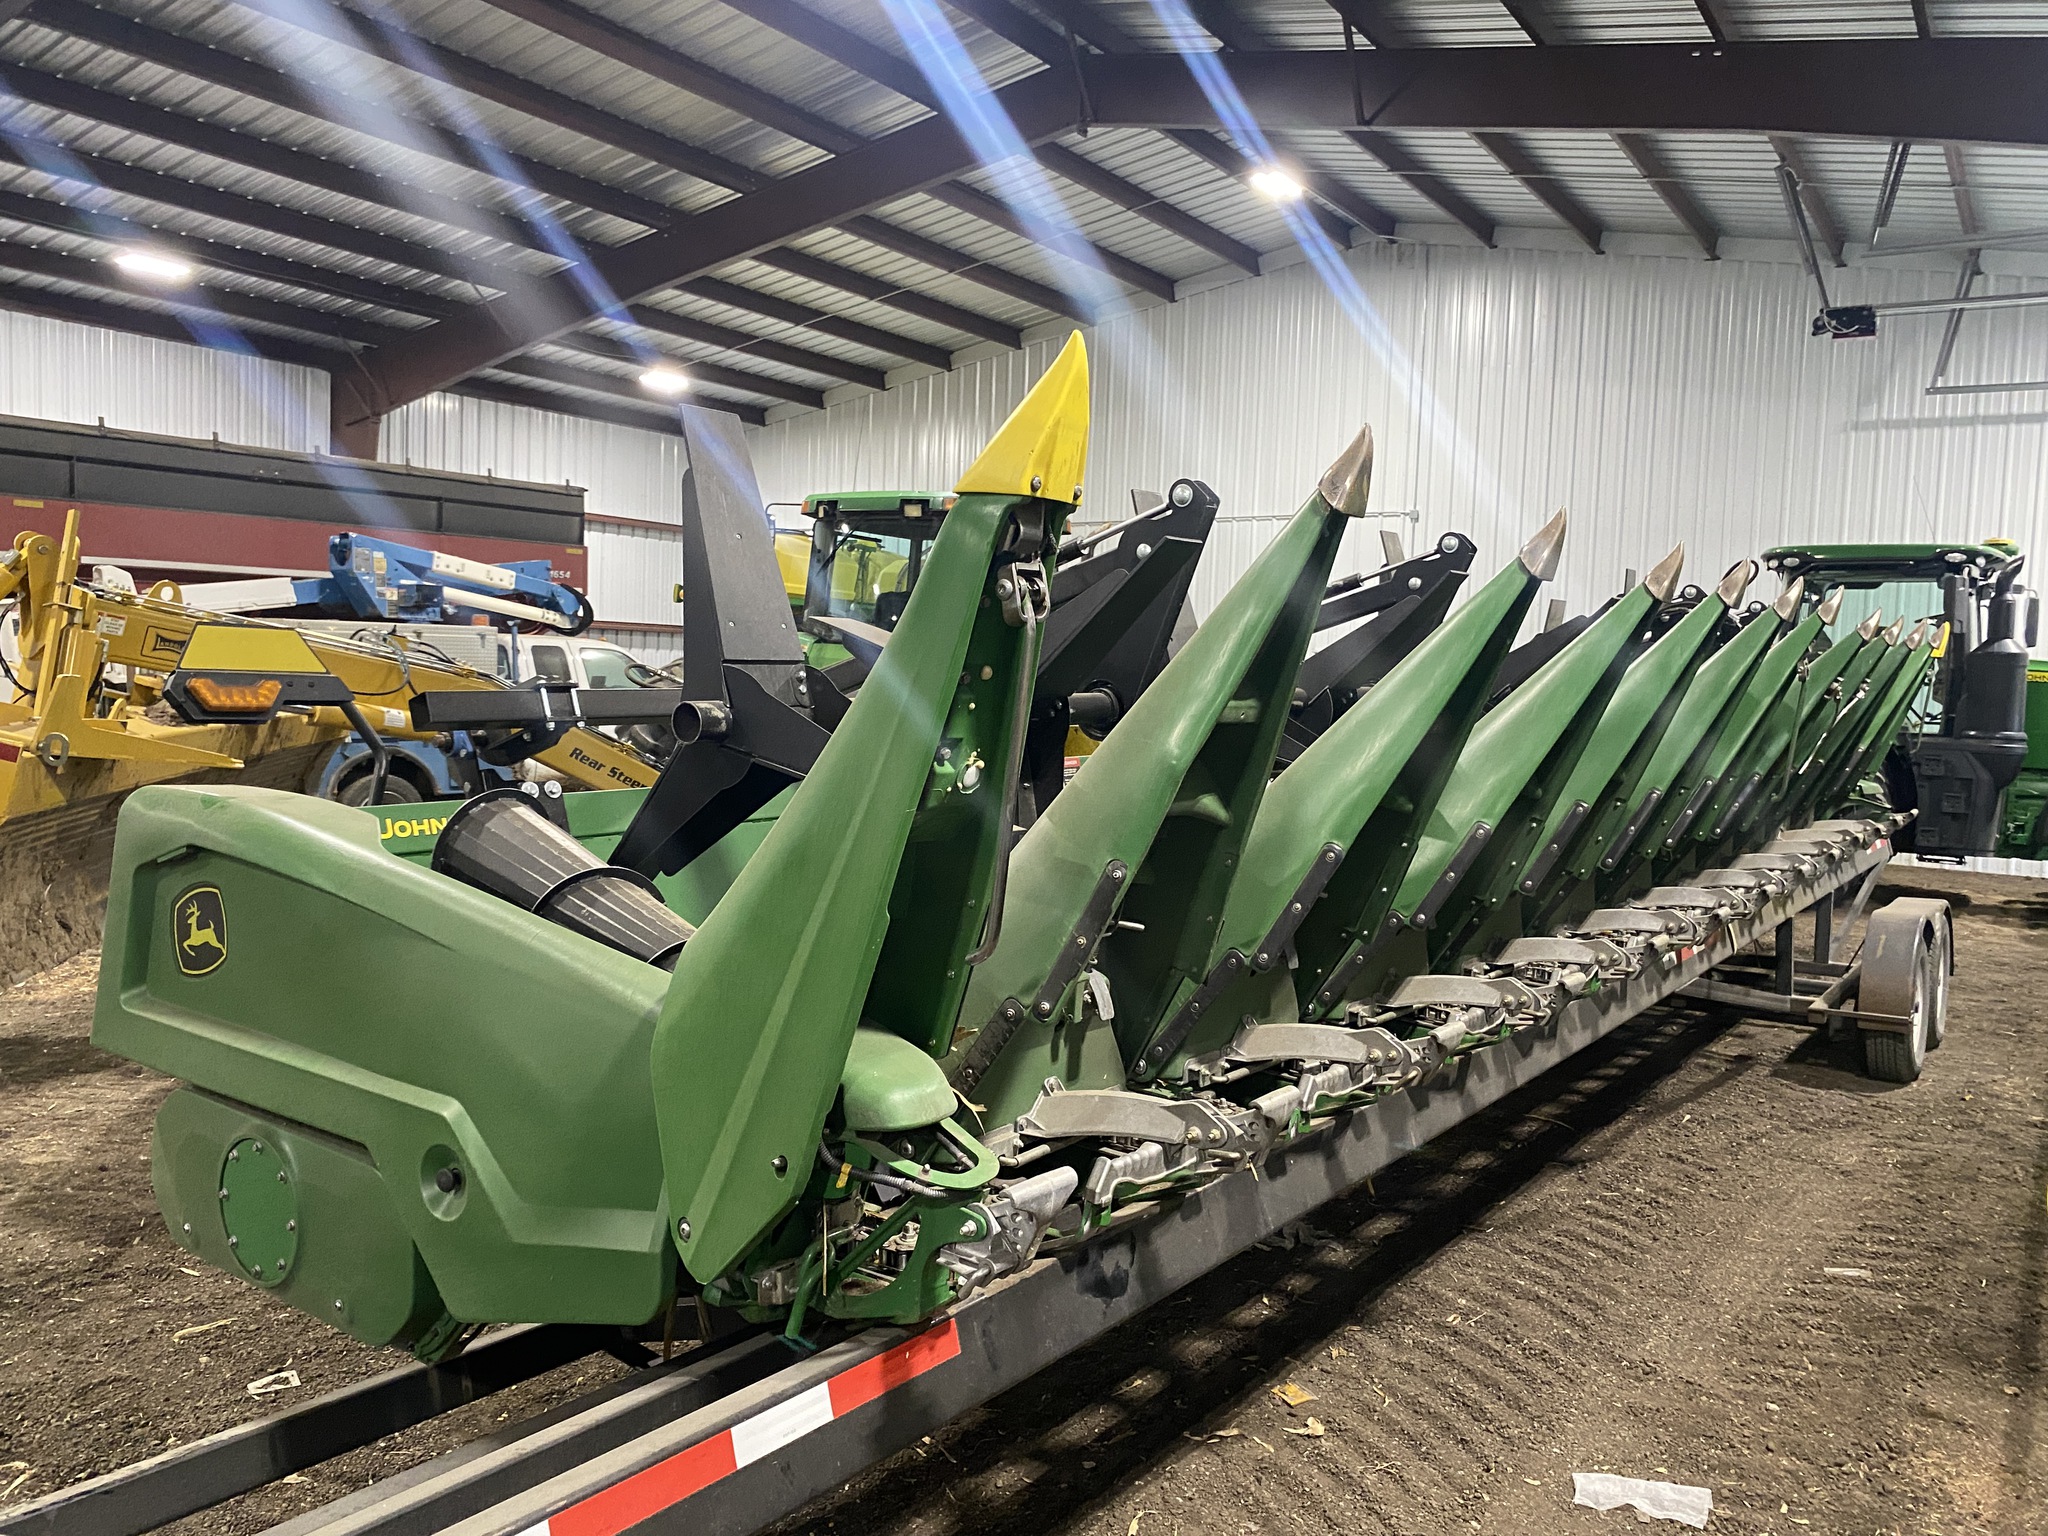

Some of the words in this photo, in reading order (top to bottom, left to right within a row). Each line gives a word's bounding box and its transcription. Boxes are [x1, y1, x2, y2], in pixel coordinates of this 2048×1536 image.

[2026, 673, 2048, 682] OHN
[569, 747, 606, 771] Rear
[381, 817, 448, 840] JOHN
